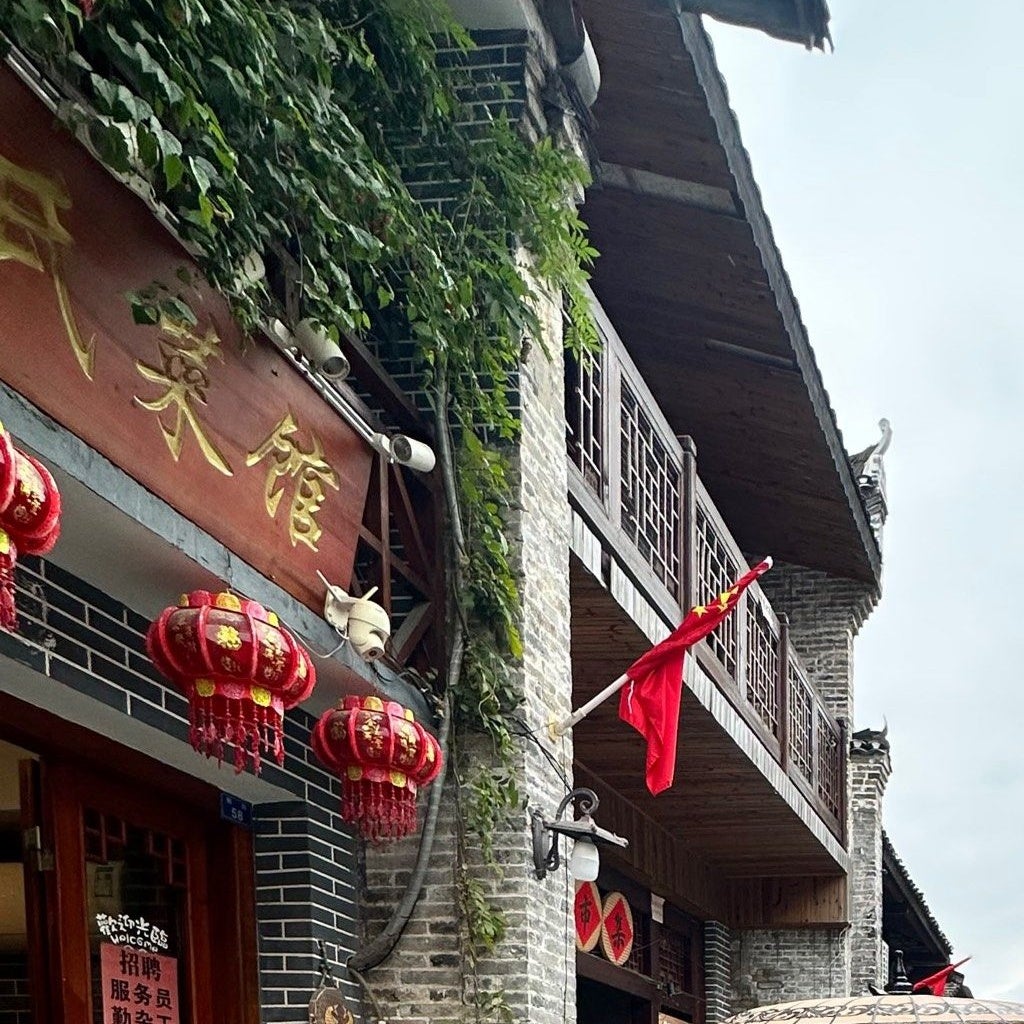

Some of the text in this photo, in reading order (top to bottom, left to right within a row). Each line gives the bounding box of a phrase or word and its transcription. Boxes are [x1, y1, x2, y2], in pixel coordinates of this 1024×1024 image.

[119, 949, 161, 981] 招聘
[111, 979, 172, 1010] 服务员
